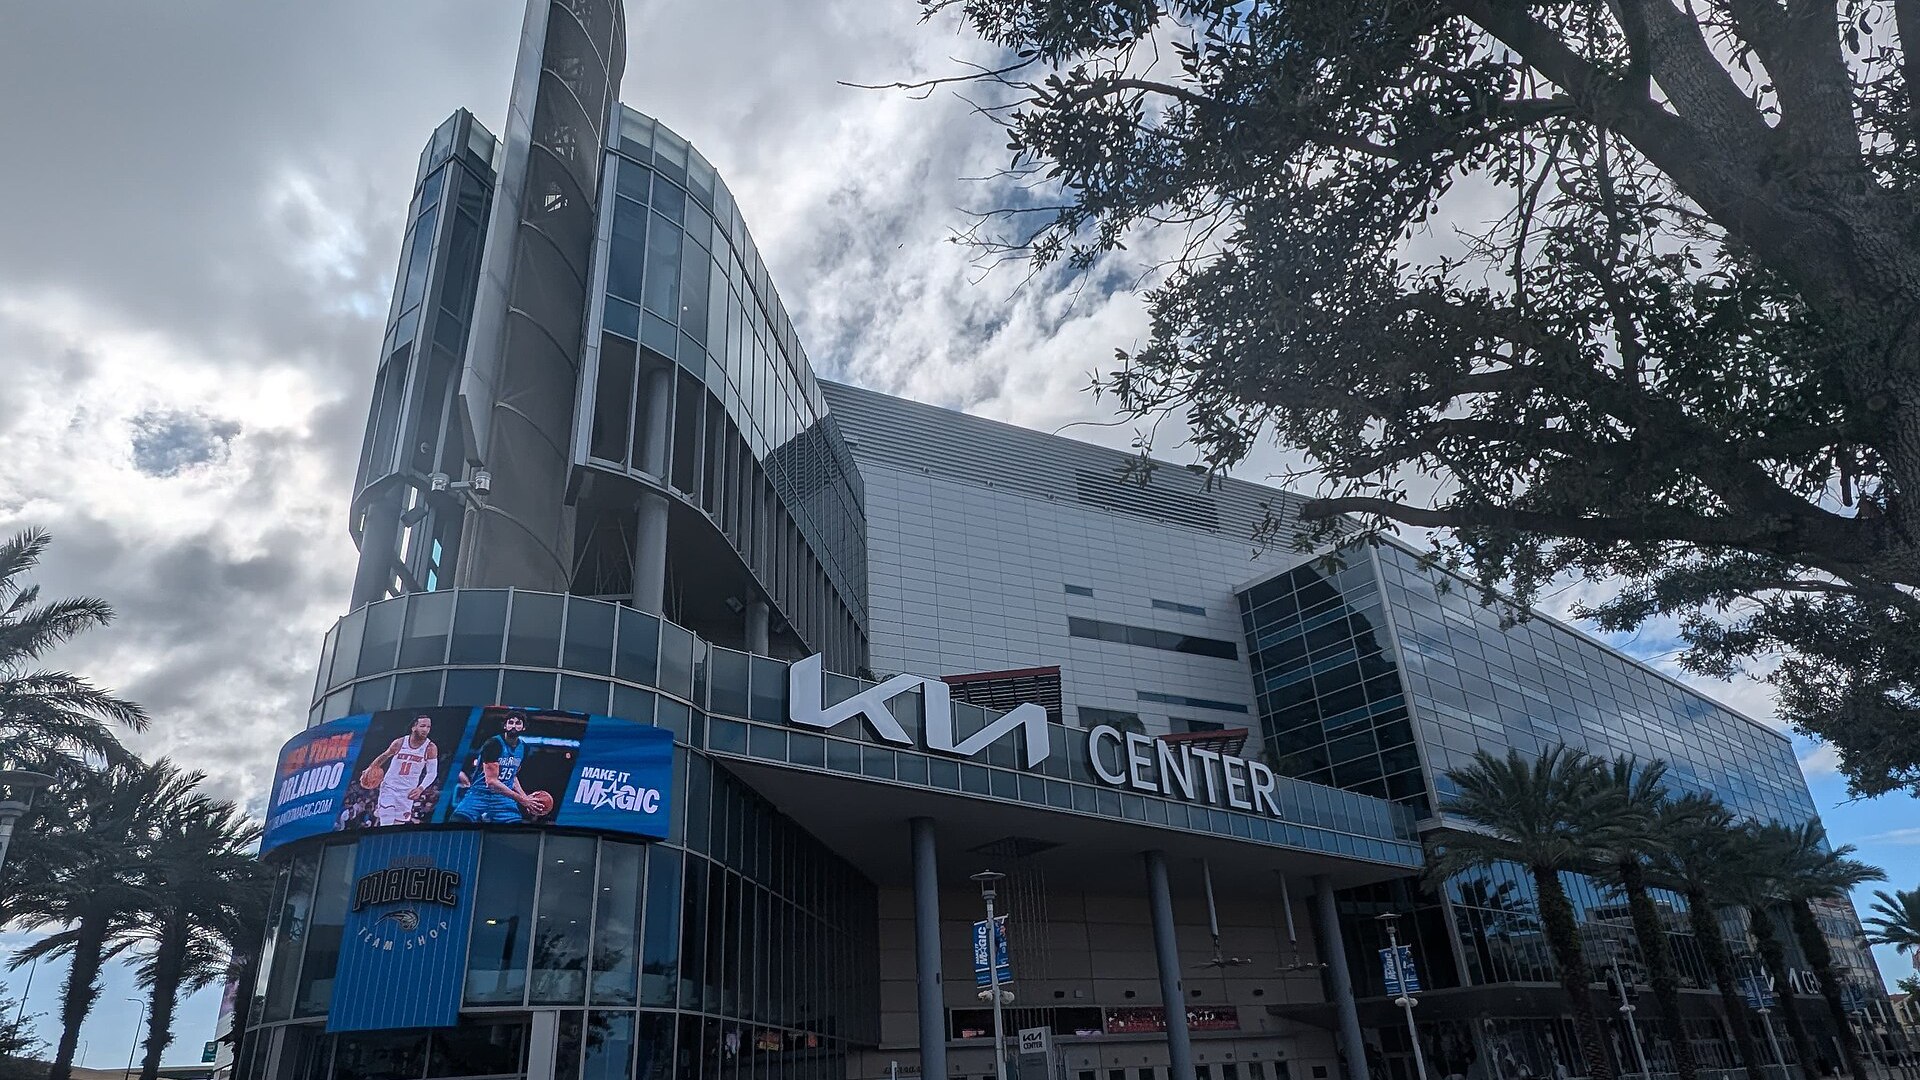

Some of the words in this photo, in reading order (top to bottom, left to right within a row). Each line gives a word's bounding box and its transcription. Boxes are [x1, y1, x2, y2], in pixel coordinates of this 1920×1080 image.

[789, 652, 1050, 769] KIA
[1088, 724, 1282, 817] CENTER
[277, 762, 345, 806] ORLANDO
[498, 767, 514, 780] 35
[581, 766, 617, 781] MAKE
[618, 771, 631, 783] IT
[574, 778, 660, 814] MAGIC
[352, 866, 460, 912] MAGIC
[358, 926, 394, 951] TEAM
[407, 921, 448, 950] SHOP
[1023, 1032, 1042, 1041] KIA
